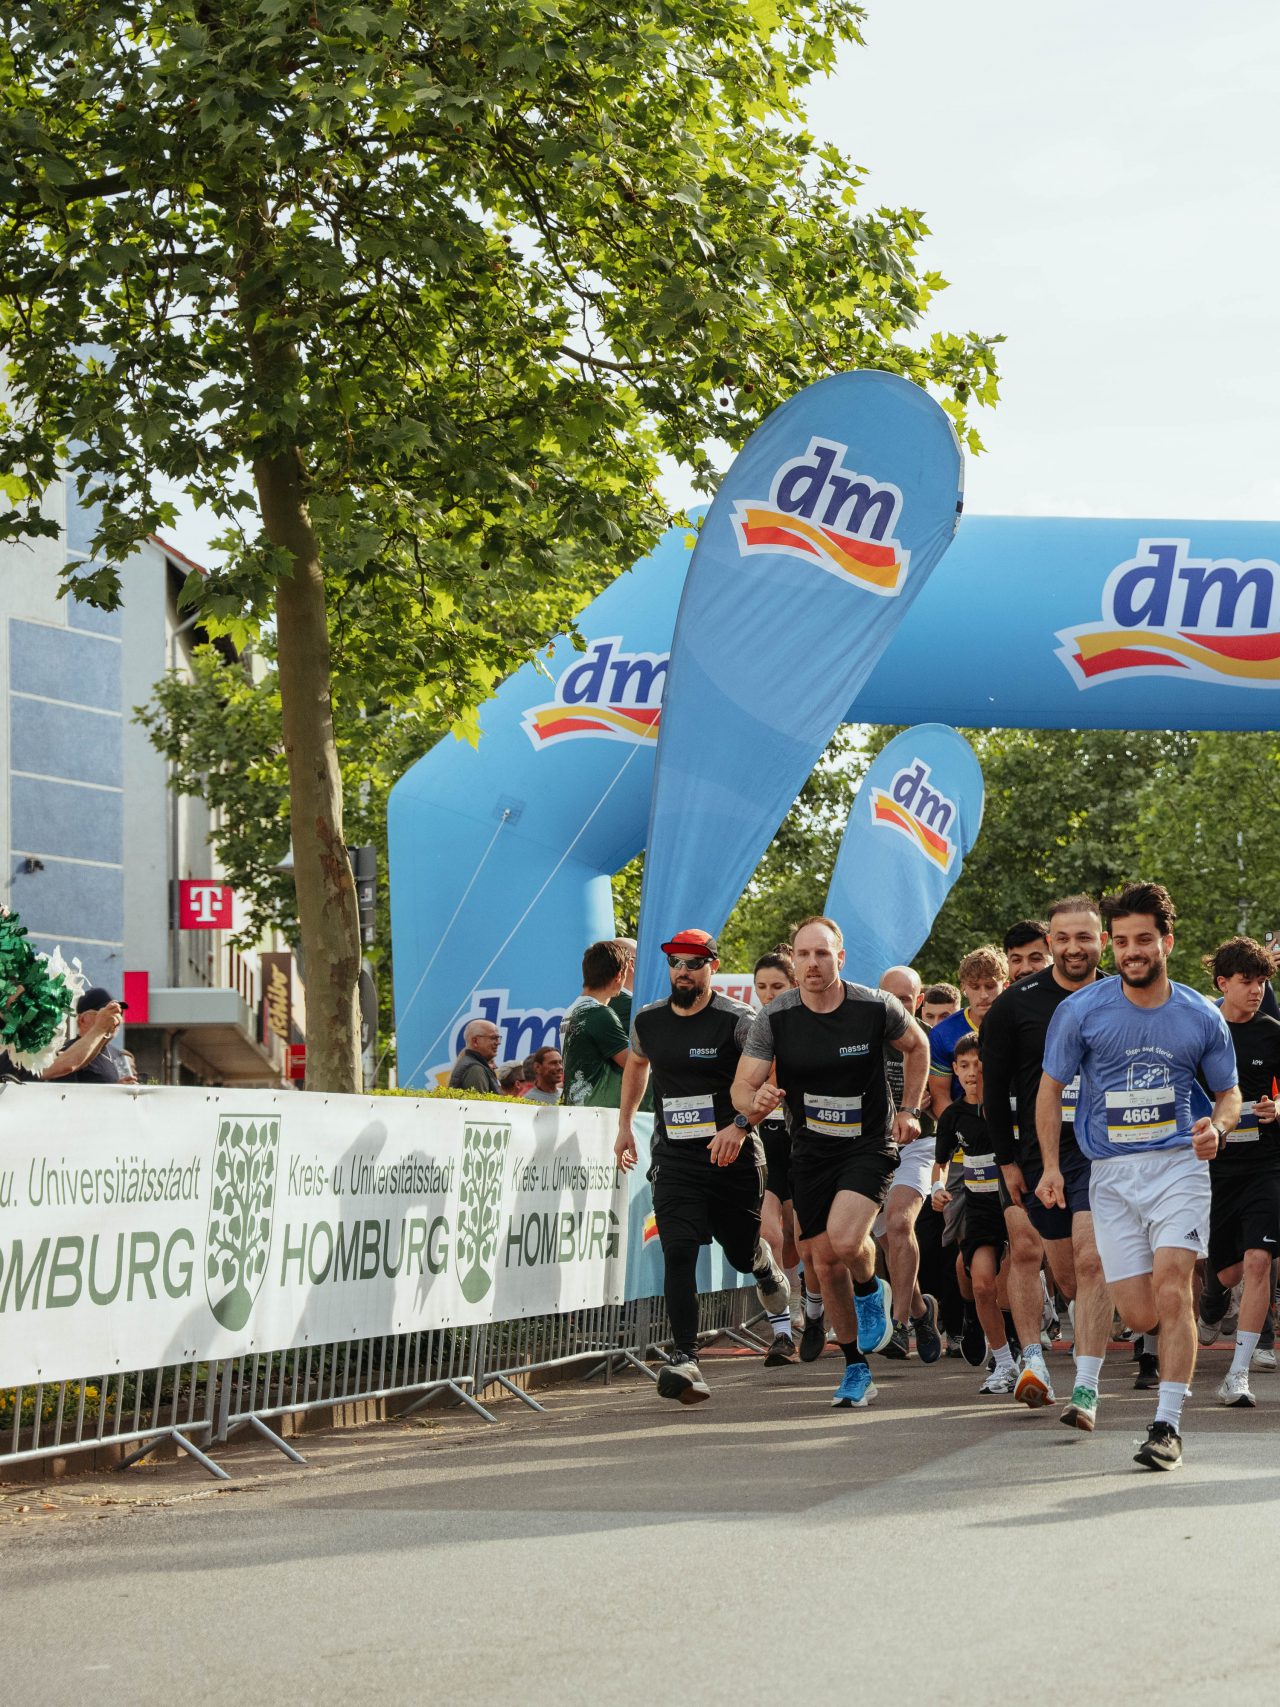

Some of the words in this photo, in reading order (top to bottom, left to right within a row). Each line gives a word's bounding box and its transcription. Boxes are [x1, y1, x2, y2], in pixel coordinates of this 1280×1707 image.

[777, 446, 896, 541] dm
[1113, 545, 1274, 628] dm
[562, 643, 670, 704] dm
[893, 764, 952, 835] dm
[190, 887, 222, 922] T
[839, 1043, 869, 1054] massar
[1155, 1047, 1174, 1059] Stories
[671, 1111, 700, 1124] 4592
[817, 1109, 846, 1122] 4591
[1122, 1107, 1160, 1123] 4664
[28, 1155, 201, 1207] Universitätsstadt
[288, 1154, 329, 1197] Kreis-
[332, 1165, 345, 1196] u.
[350, 1154, 455, 1195] Universitätsstadt
[0, 1228, 195, 1313] MBURG
[280, 1216, 450, 1287] HOMBURG
